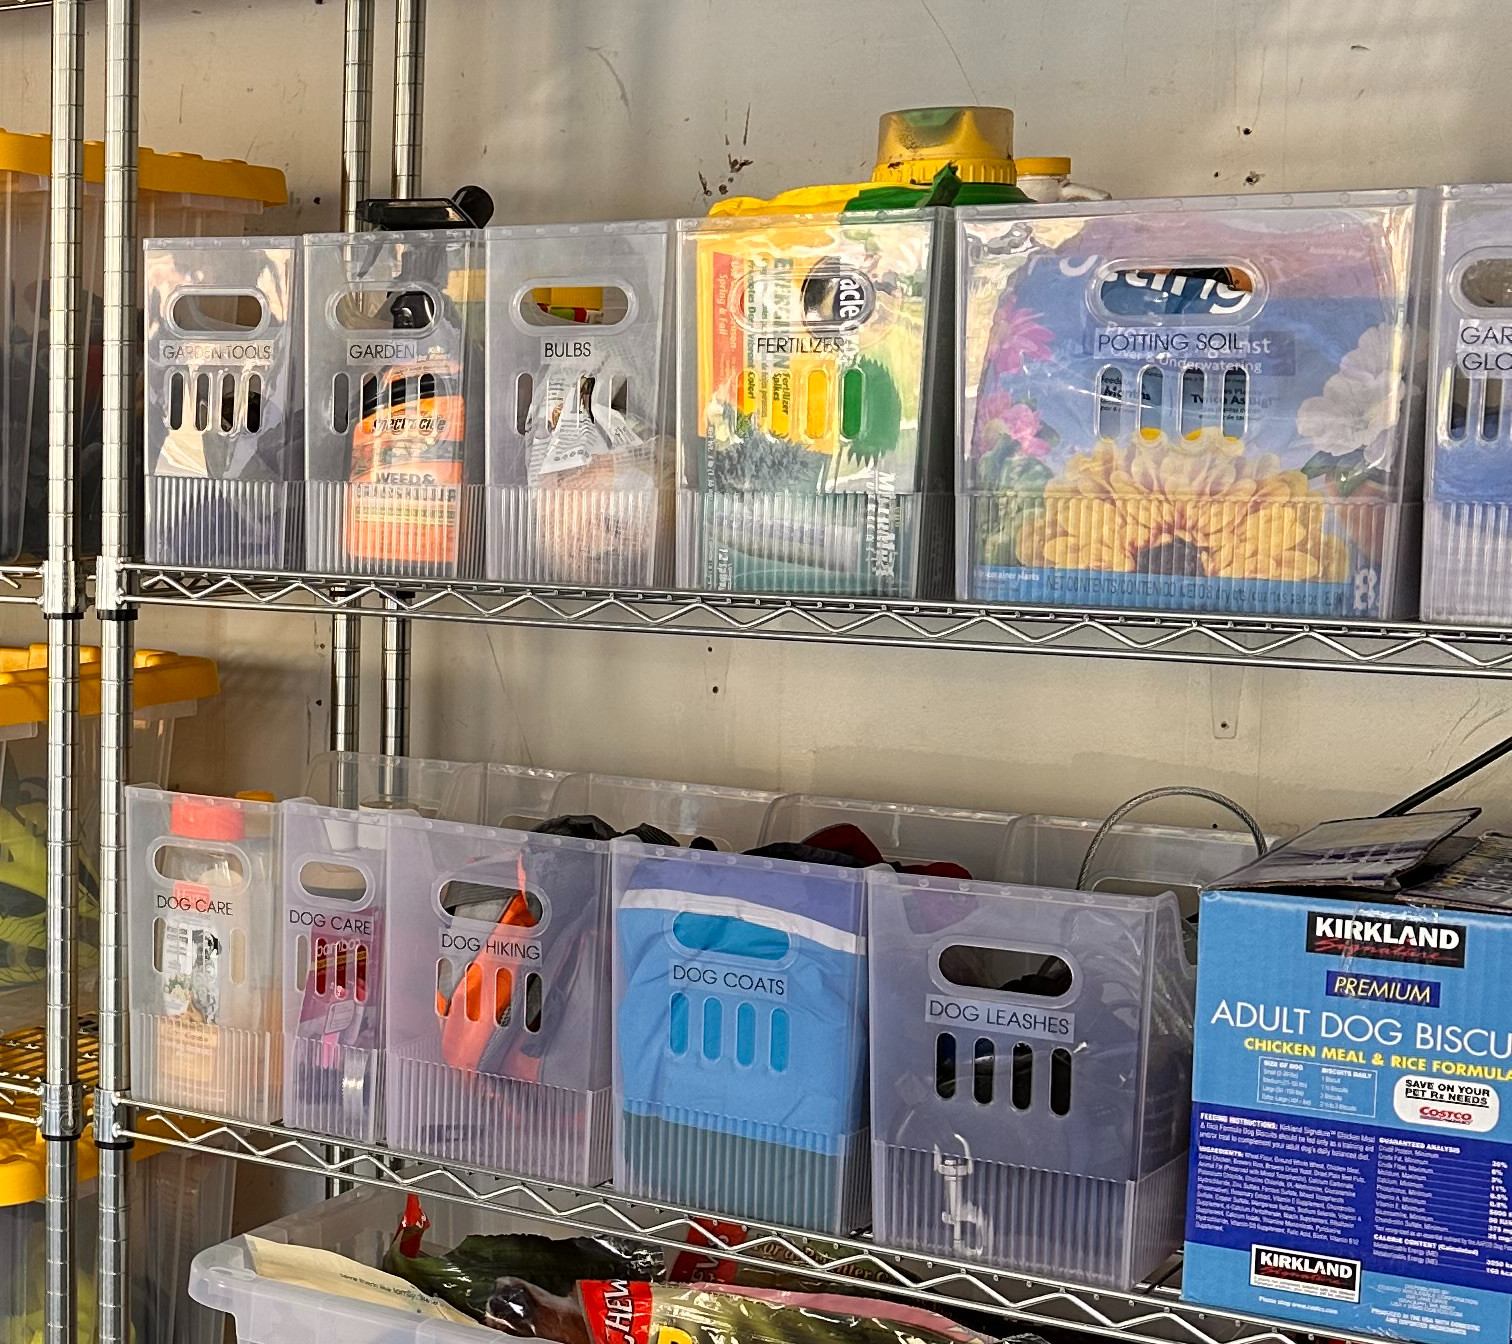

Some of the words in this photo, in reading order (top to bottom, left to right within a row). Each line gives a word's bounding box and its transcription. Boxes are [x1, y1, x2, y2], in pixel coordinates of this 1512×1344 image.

[162, 344, 222, 360] GARDEN
[222, 344, 271, 361] TOOLS
[349, 344, 416, 360] GARDEN
[543, 341, 591, 358] BULBS
[757, 337, 844, 354] FERTILIZER
[1098, 333, 1188, 351] POTTING
[1196, 333, 1243, 351] SOIL
[157, 895, 191, 911] DOG
[196, 899, 233, 916] CARE
[289, 909, 326, 928] DOG
[331, 916, 371, 935] CARE
[1315, 915, 1460, 951] KIRKLAND
[441, 933, 480, 953] DOG
[486, 939, 540, 960] HIKING
[672, 964, 717, 987] DOG
[723, 972, 785, 996] COATS
[1334, 976, 1431, 1004] PREMIUM
[929, 1000, 980, 1023] DOG
[986, 1008, 1070, 1036] LEASHES
[1211, 999, 1310, 1038] ADULT
[1320, 1011, 1404, 1046] DOG
[1244, 1037, 1316, 1058] CHICKEN
[1321, 1047, 1367, 1066] MEAL
[1373, 1052, 1384, 1067] &
[1390, 1055, 1428, 1072] RICE
[1405, 1079, 1434, 1090] SAVE
[1438, 1083, 1455, 1092] ON
[1458, 1085, 1489, 1097] YOUR
[1405, 1089, 1427, 1099] PET
[1448, 1094, 1488, 1105] NEEDS
[1419, 1106, 1472, 1121] COSTCO
[1260, 1252, 1353, 1279] KIRKLAND
